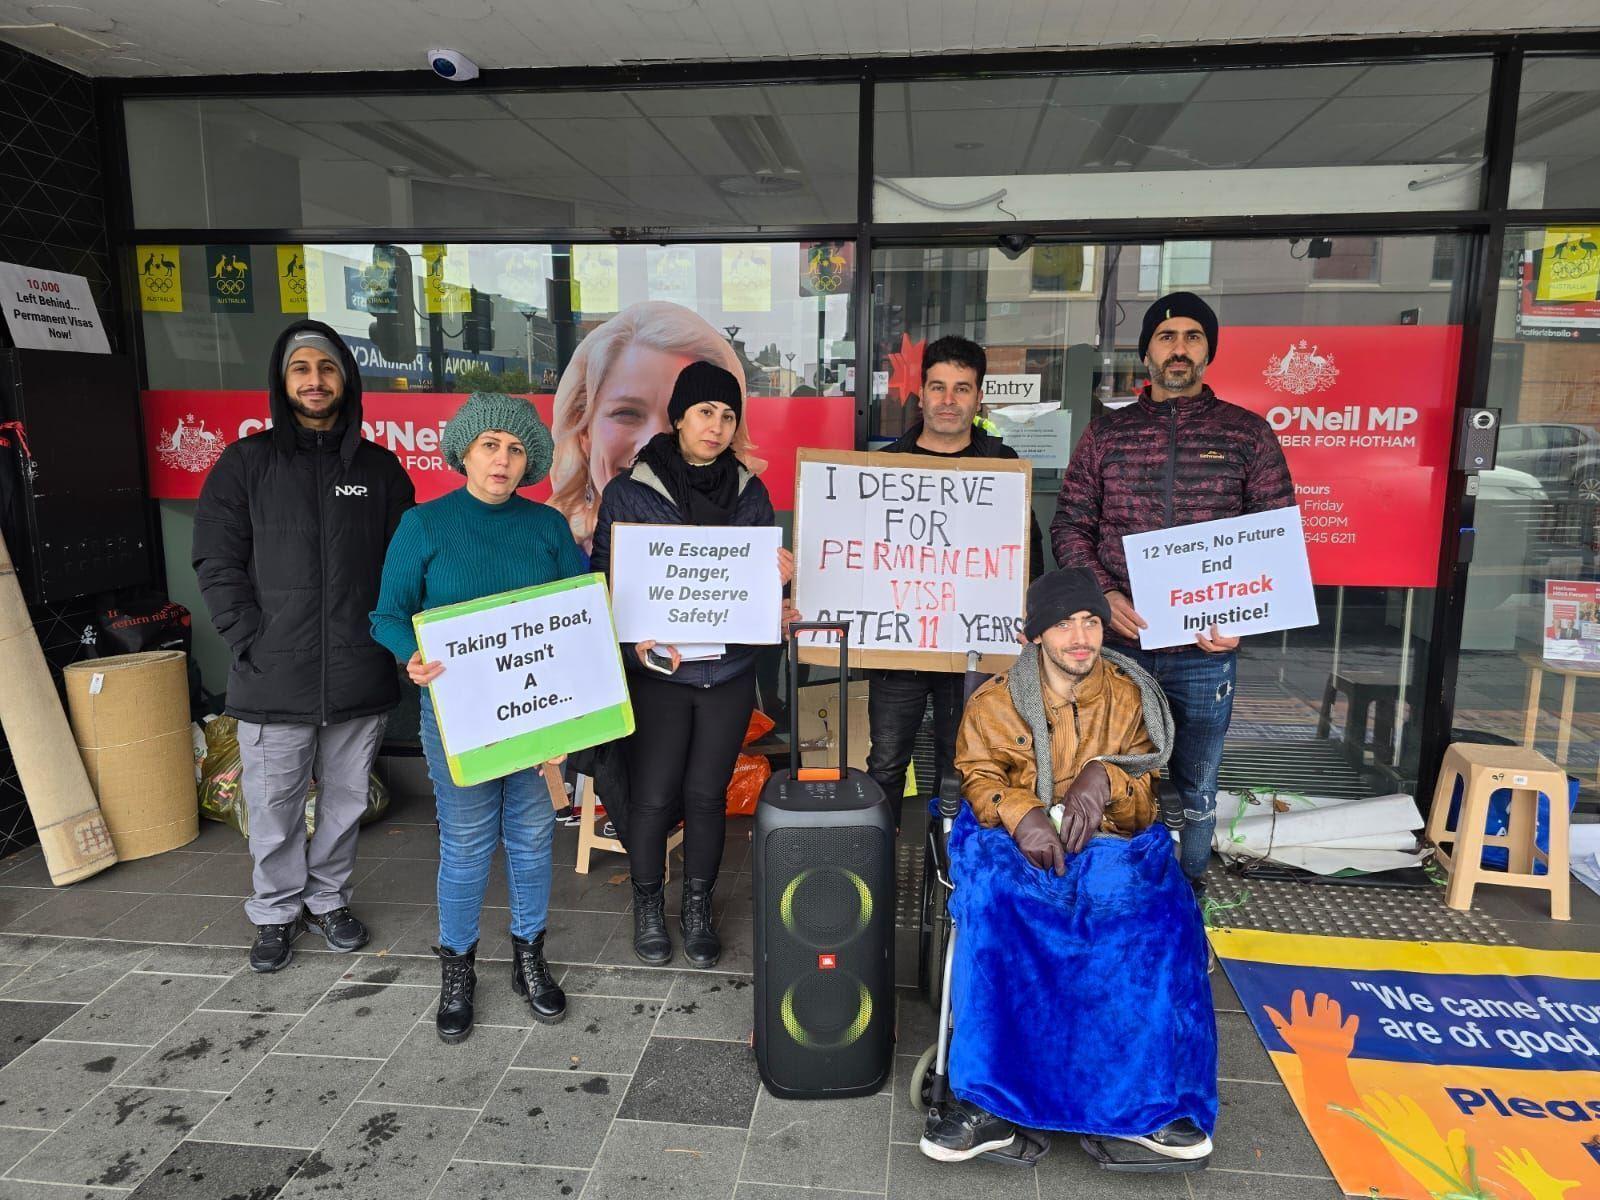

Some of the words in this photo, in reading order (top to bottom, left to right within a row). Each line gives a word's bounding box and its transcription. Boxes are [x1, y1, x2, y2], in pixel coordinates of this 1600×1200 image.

[27, 280, 60, 293] 10,000
[16, 292, 38, 304] Left
[39, 295, 80, 310] Behind...
[13, 309, 67, 325] Permanent
[68, 316, 94, 328] Visas
[48, 328, 72, 340] Now!
[985, 380, 1034, 397] Entry
[1367, 407, 1418, 431] MP
[1279, 436, 1311, 447] BER
[1314, 436, 1345, 447] FOR
[1350, 436, 1416, 447] HOTHAM
[406, 456, 443, 470] FOR
[335, 485, 368, 497] NXP
[826, 466, 837, 500] I
[858, 472, 995, 506] DESERVE
[1294, 483, 1330, 494] hours
[1304, 500, 1344, 512] Friday
[883, 508, 952, 547] FOR
[1300, 516, 1348, 527] 5:00PM
[1142, 546, 1160, 560] 12
[1163, 541, 1209, 557] Years,
[1213, 534, 1234, 548] No
[1237, 527, 1285, 544] Future
[1331, 533, 1356, 543] 6211
[648, 542, 674, 557] We
[678, 542, 751, 560] Escaped
[819, 539, 1022, 581] PERMANENT
[666, 564, 730, 582] Danger,
[1202, 555, 1232, 574] End
[648, 586, 674, 601] We
[678, 586, 748, 601] Deserve
[890, 580, 957, 612] VISA
[1170, 574, 1273, 607] FastTrack
[112, 615, 149, 629] return
[667, 608, 729, 627] Safety!
[1183, 602, 1269, 632] Injustice!
[446, 632, 507, 658] Taking
[511, 622, 545, 641] The
[550, 608, 592, 631] Boat,
[810, 609, 913, 645] AFTER
[918, 615, 940, 649] 11
[959, 613, 1025, 645] YEARS
[495, 643, 555, 672] Wasn't
[524, 672, 538, 690] A
[497, 693, 573, 721] Choice...
[1350, 981, 1434, 1014] "We
[1440, 995, 1540, 1019] came
[1537, 996, 1600, 1024] fro
[1378, 1016, 1443, 1045] are
[1448, 1022, 1493, 1050] of
[1495, 1027, 1600, 1058] good
